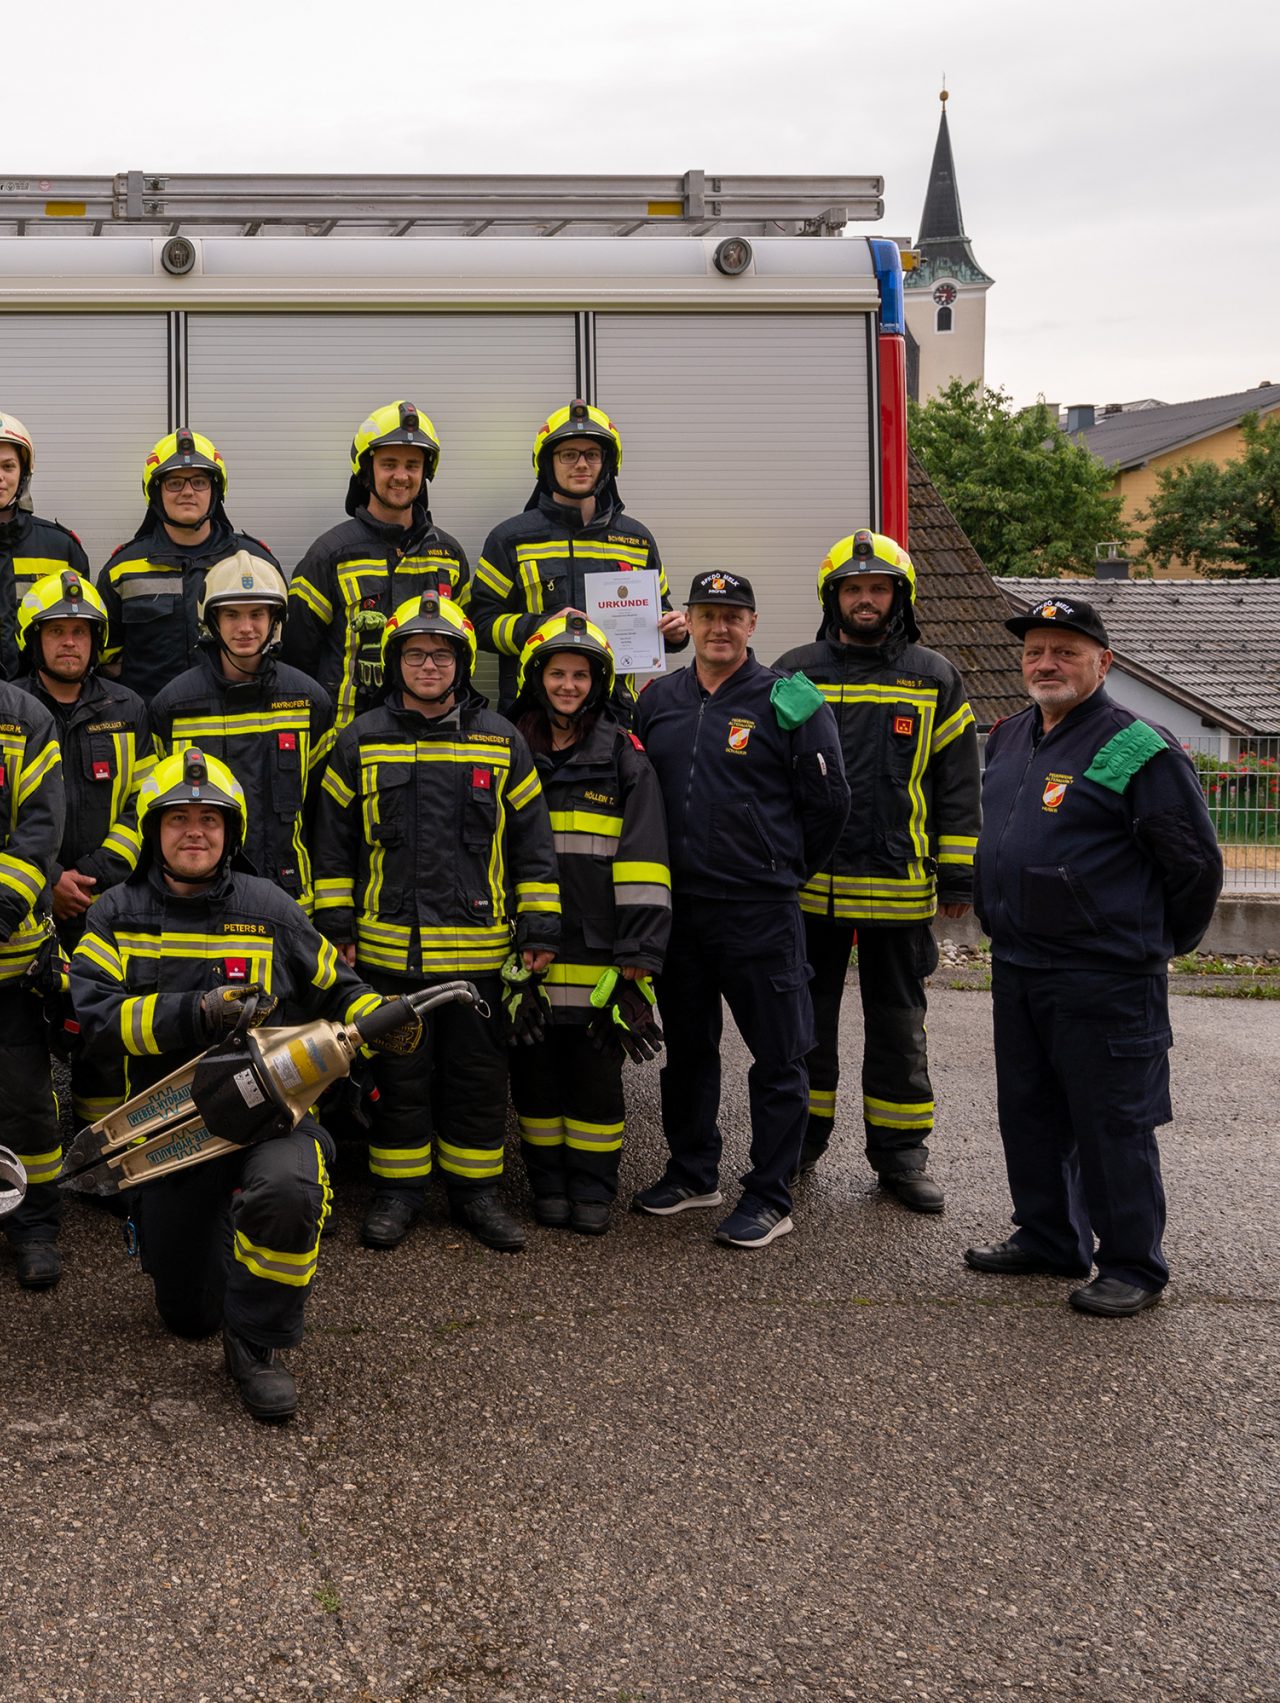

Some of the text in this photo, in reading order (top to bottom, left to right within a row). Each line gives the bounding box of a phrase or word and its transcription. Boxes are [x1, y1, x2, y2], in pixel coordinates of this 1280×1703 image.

[722, 574, 740, 587] MELK
[598, 599, 649, 608] URKUNDE
[1054, 601, 1075, 615] MELK
[271, 700, 304, 709] MAYRHOFER
[223, 923, 256, 933] PETERS
